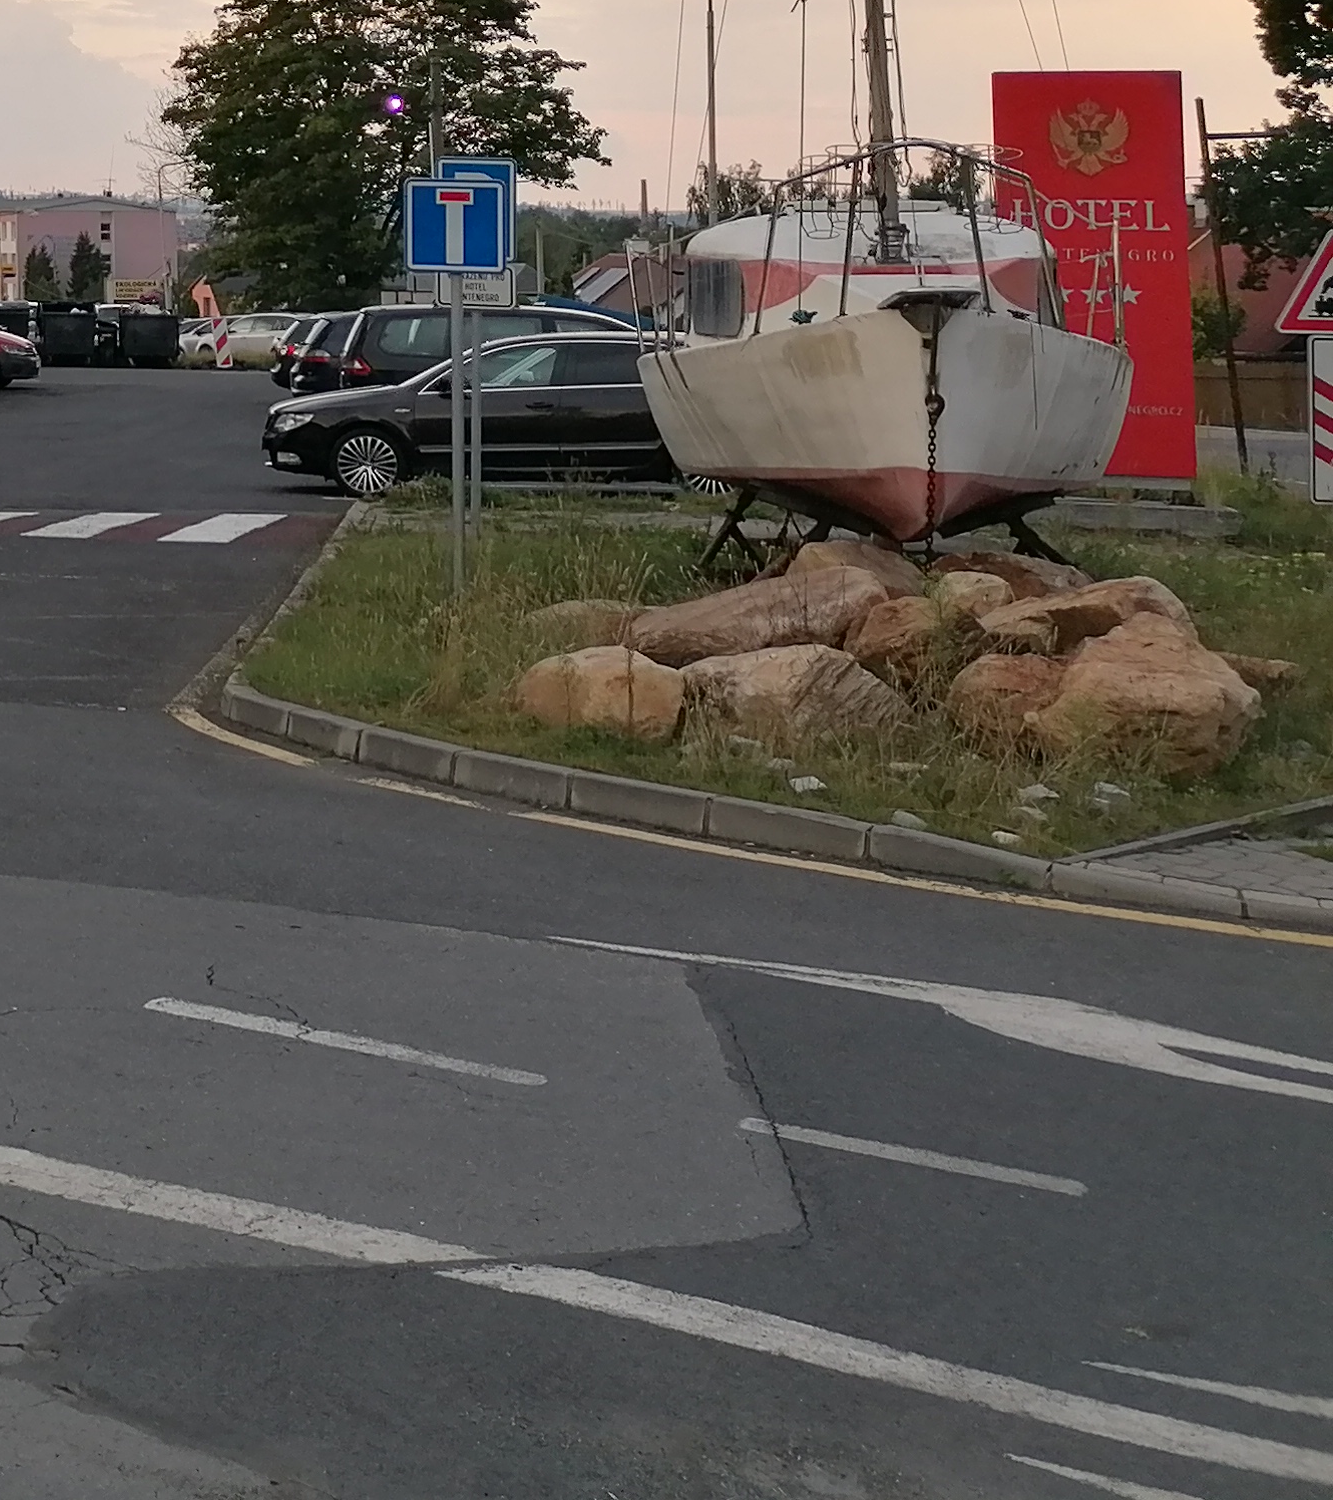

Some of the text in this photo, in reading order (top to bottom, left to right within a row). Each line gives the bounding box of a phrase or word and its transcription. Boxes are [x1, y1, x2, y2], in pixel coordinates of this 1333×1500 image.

[1011, 198, 1172, 232] HOTEL
[464, 283, 487, 292] HOTEL
[462, 293, 500, 302] NTENEGRO
